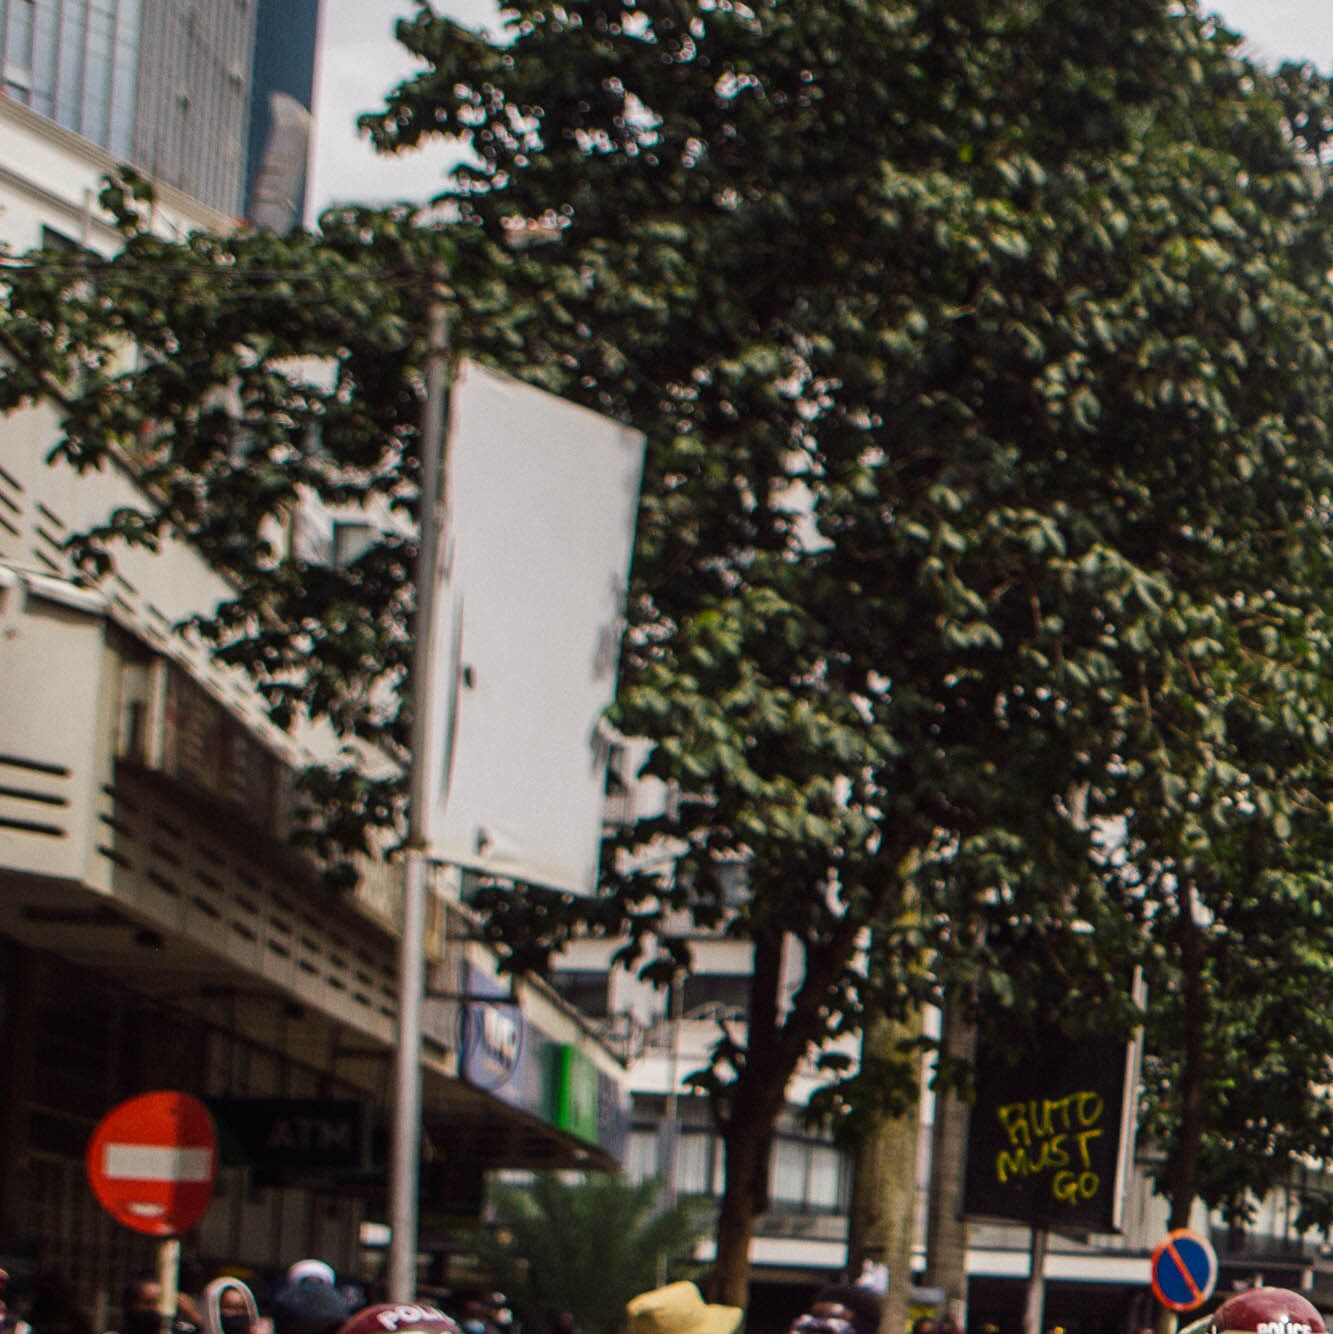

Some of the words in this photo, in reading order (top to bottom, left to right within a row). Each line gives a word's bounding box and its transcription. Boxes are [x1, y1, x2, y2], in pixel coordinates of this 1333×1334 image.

[999, 1091, 1104, 1146] RUTO
[997, 1129, 1104, 1184] MUST
[1052, 1170, 1100, 1206] GO
